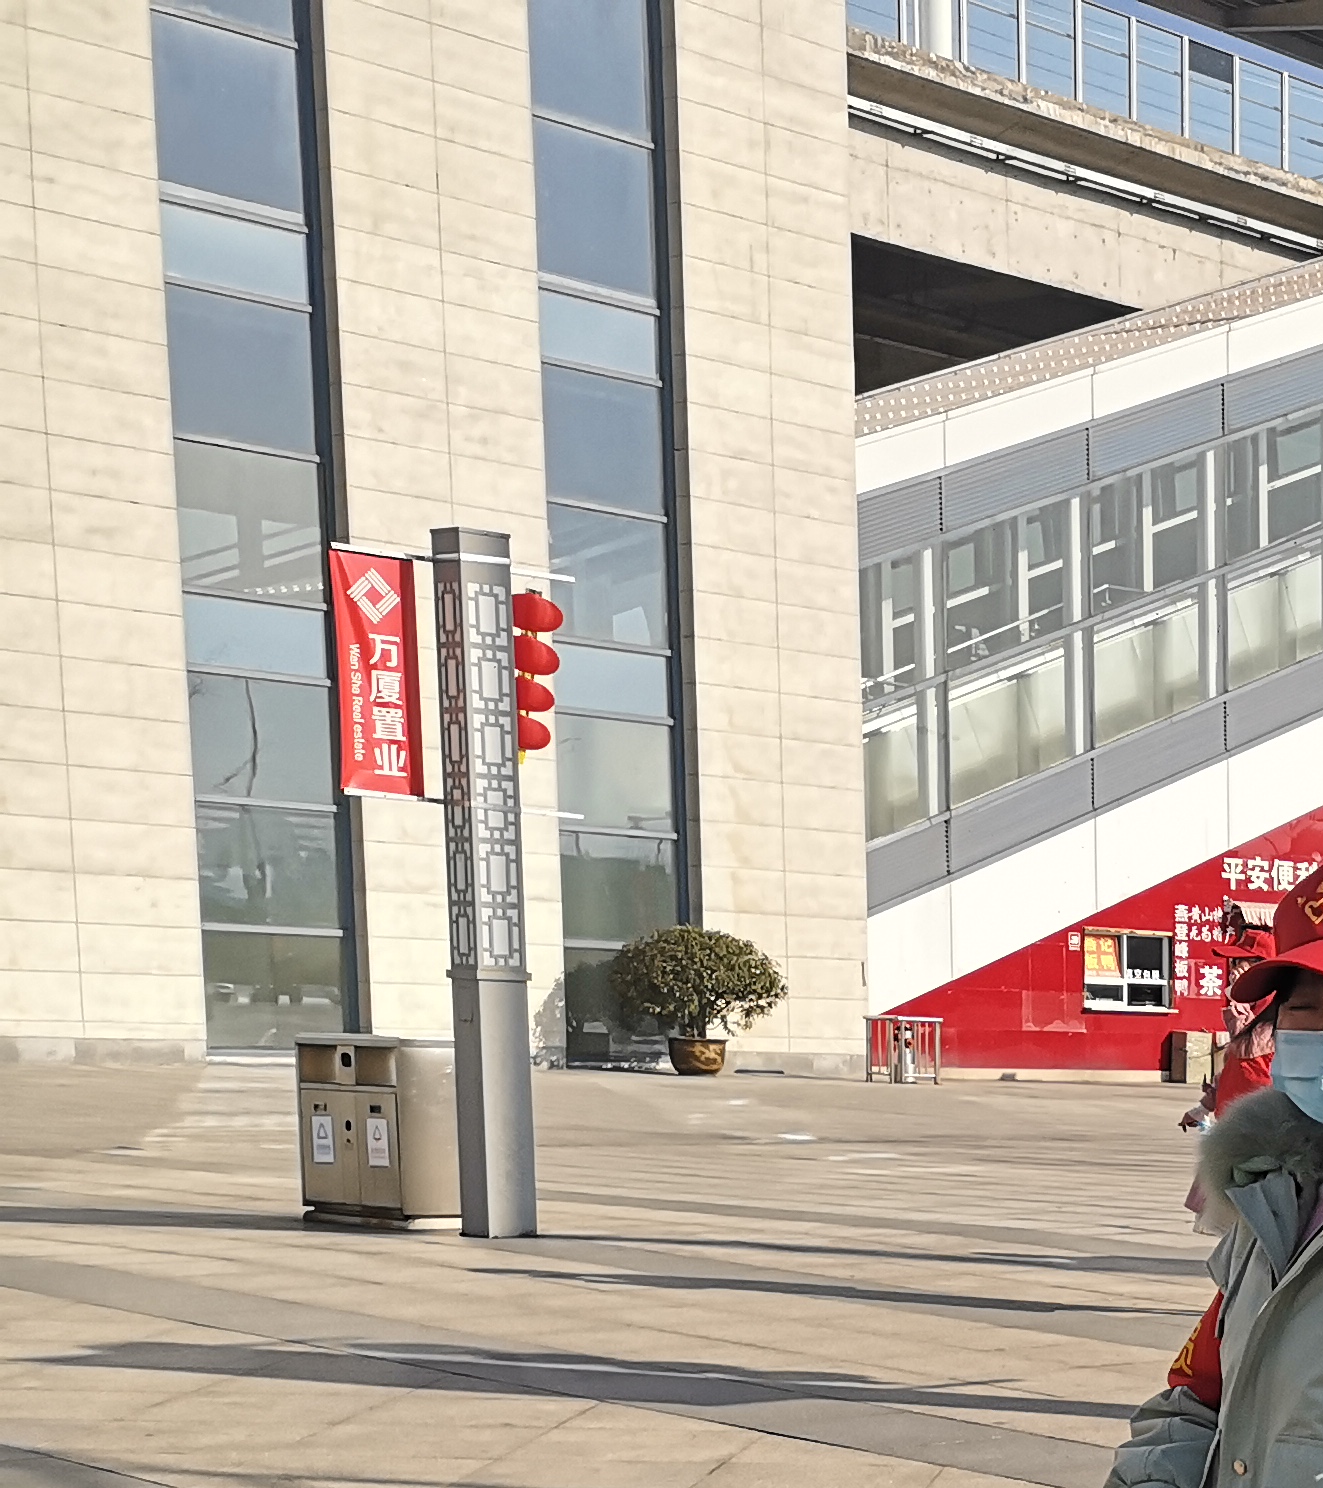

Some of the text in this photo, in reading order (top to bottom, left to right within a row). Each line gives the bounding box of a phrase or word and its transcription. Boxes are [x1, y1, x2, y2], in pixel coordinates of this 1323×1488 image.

[352, 696, 365, 724] Real
[368, 632, 408, 777] 万厦置业
[353, 724, 365, 762] estate
[1200, 965, 1222, 996] 茶
